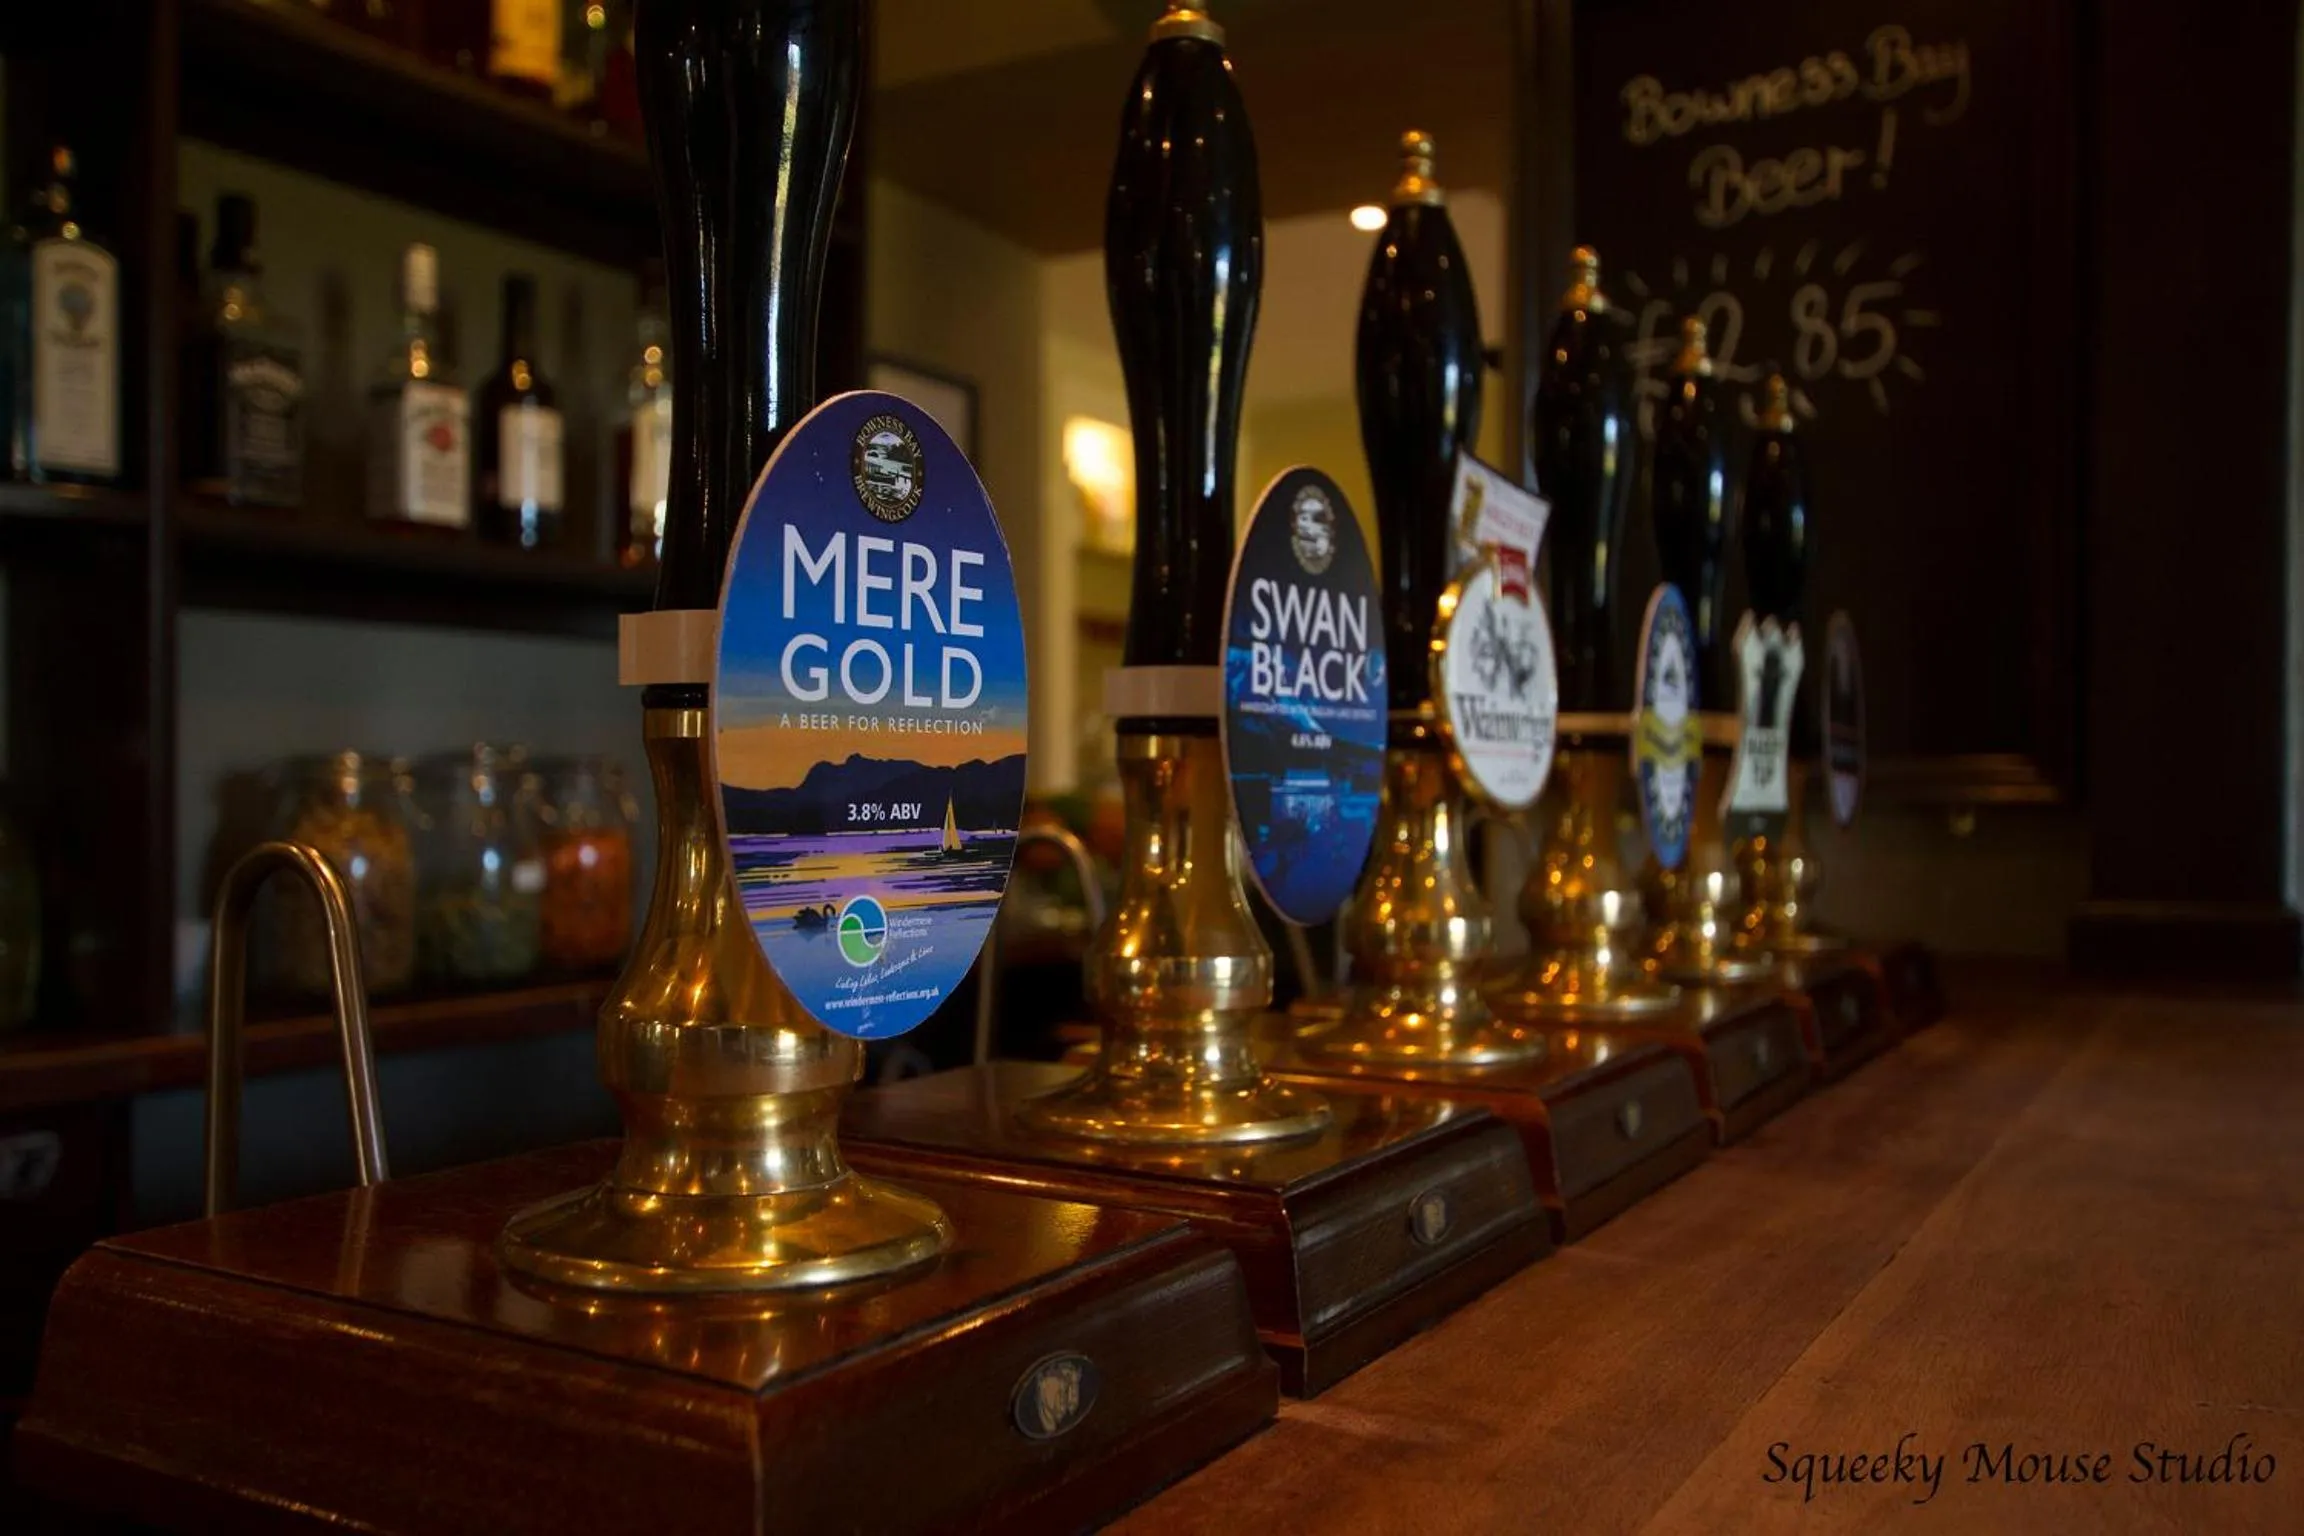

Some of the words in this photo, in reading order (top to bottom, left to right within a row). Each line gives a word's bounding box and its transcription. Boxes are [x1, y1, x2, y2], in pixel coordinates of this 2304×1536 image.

[1621, 51, 1859, 146] Bowness
[1863, 24, 1972, 126] Bay
[1688, 106, 1898, 229] Beer!
[857, 415, 905, 447] BOWNESS
[904, 430, 923, 458] BAY
[783, 523, 984, 638] MERE
[1251, 577, 1367, 652] SWAN
[780, 633, 983, 709] GOLD
[1252, 642, 1368, 703] BLACK
[780, 712, 791, 729] A
[800, 713, 840, 731] BEER
[849, 714, 880, 732] FOR
[888, 717, 983, 736] REFLECTION
[848, 803, 886, 822] 3.8%
[890, 803, 922, 820] ABV
